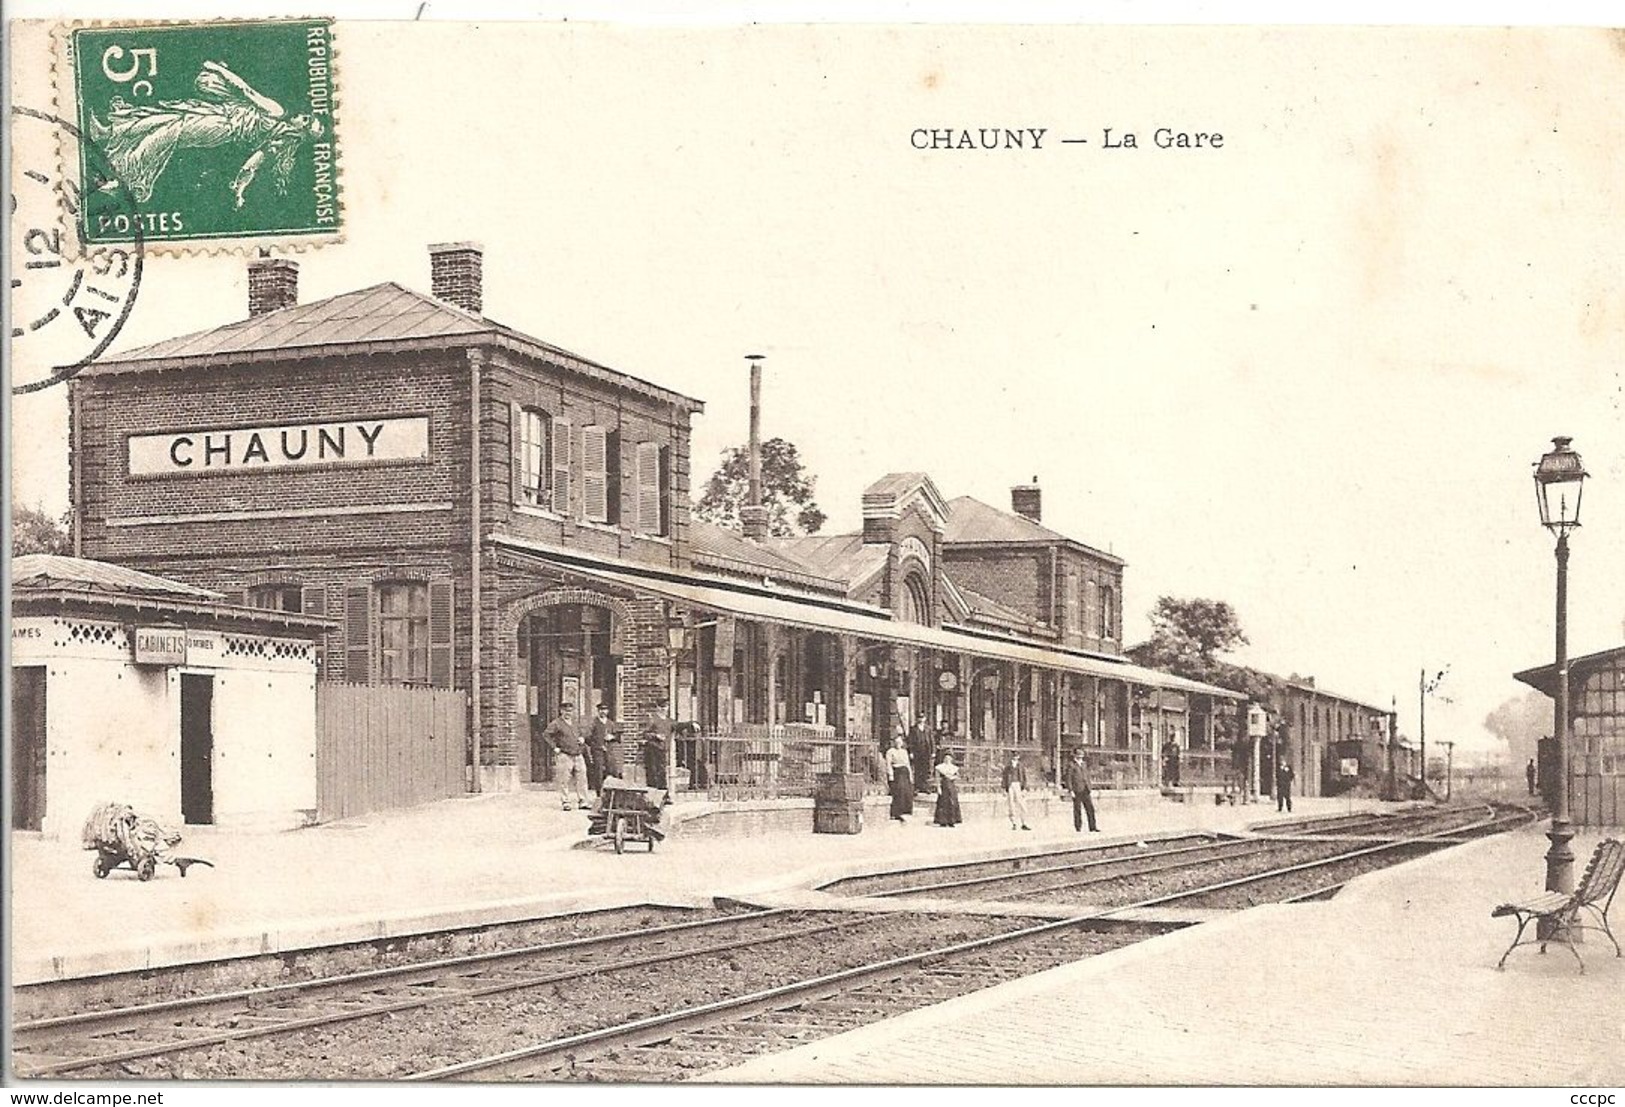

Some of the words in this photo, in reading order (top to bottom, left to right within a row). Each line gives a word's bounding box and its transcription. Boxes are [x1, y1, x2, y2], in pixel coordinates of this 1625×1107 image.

[313, 142, 335, 225] FRANÇAISE
[98, 211, 184, 234] POSTES
[169, 424, 384, 467] CHAUNY
[137, 635, 185, 654] CABINETS
